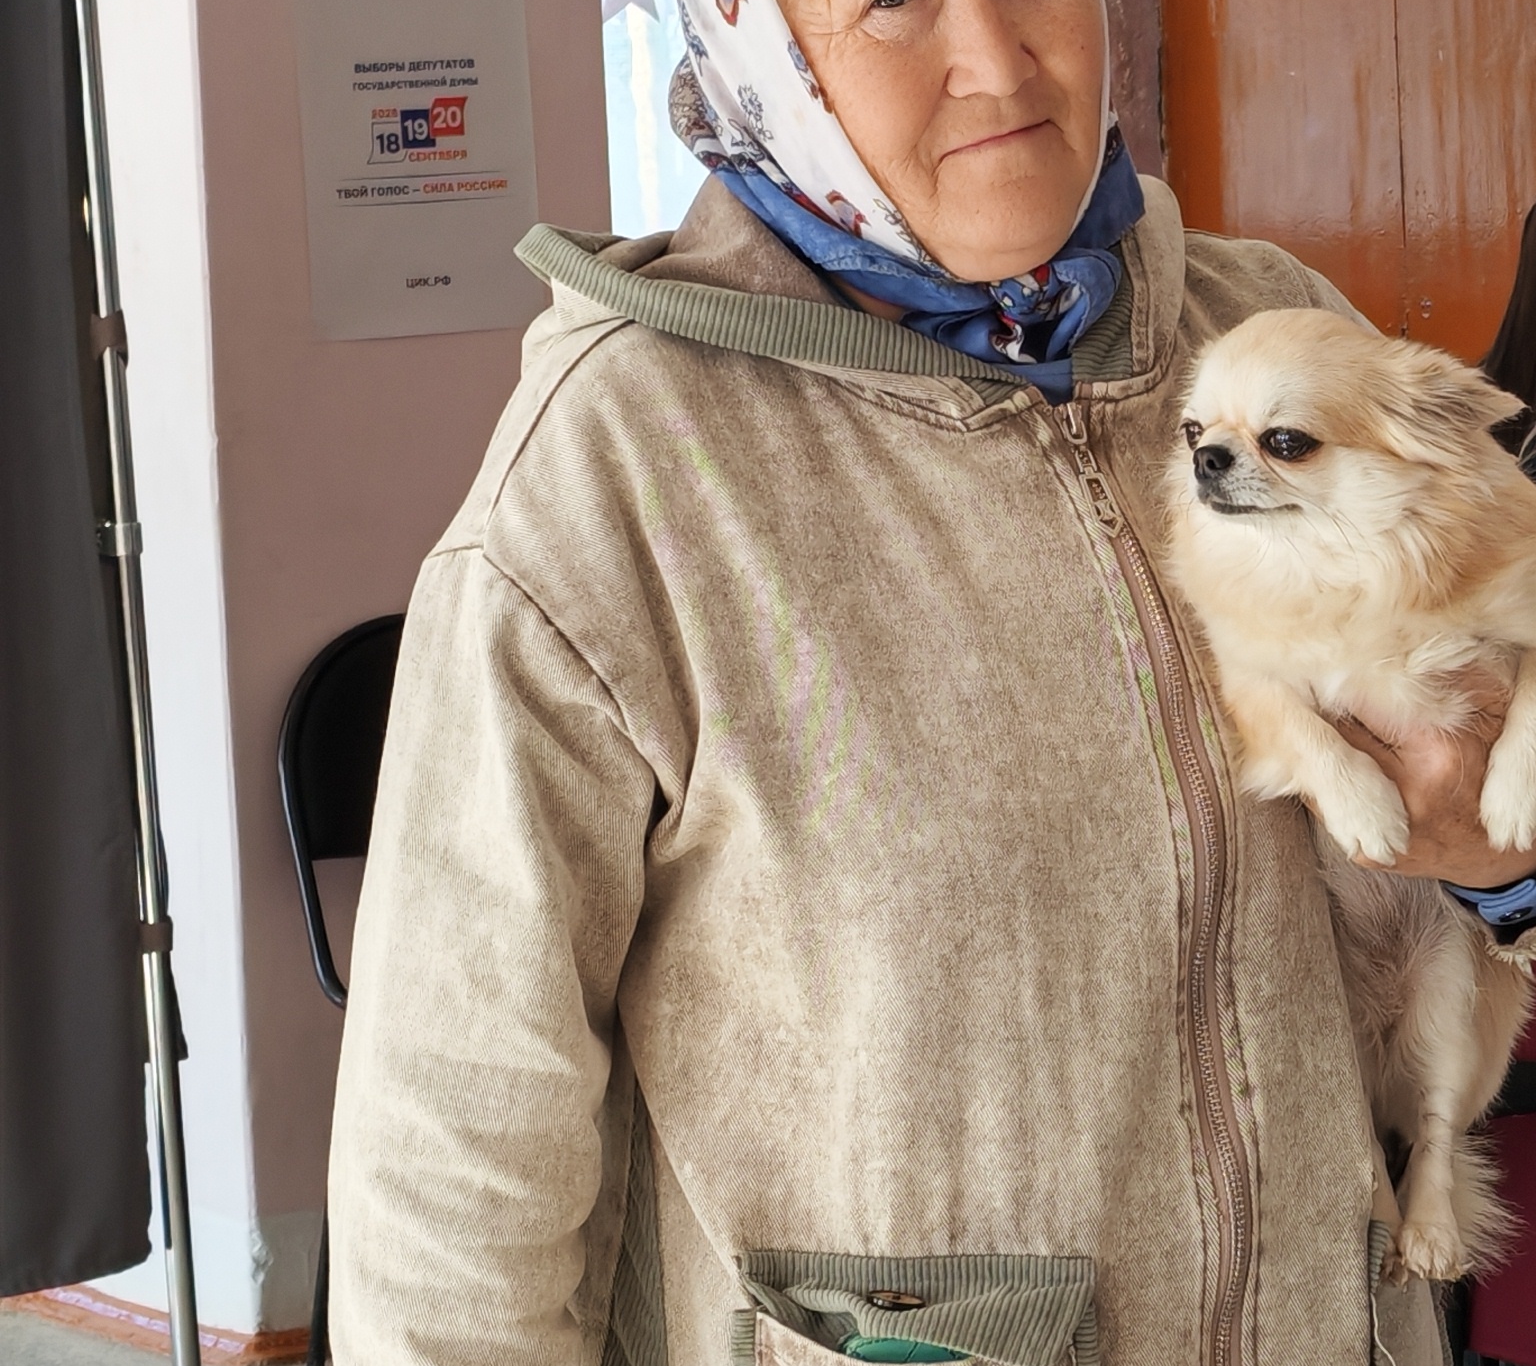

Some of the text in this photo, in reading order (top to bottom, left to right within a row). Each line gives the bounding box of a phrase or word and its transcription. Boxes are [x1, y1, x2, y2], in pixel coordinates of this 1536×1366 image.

[354, 59, 475, 74] ВЫБОРЫ ДЕПУТАТОВ
[352, 76, 478, 91] ГОСУДАРСТВЕННОЙ ДУМЫ
[375, 106, 462, 154] 18 19 20
[408, 150, 468, 163] СЕНТЯБРЯ
[336, 185, 369, 200] ТВОЙ
[371, 185, 410, 198] ГОЛОС
[423, 182, 455, 195] СИЛА
